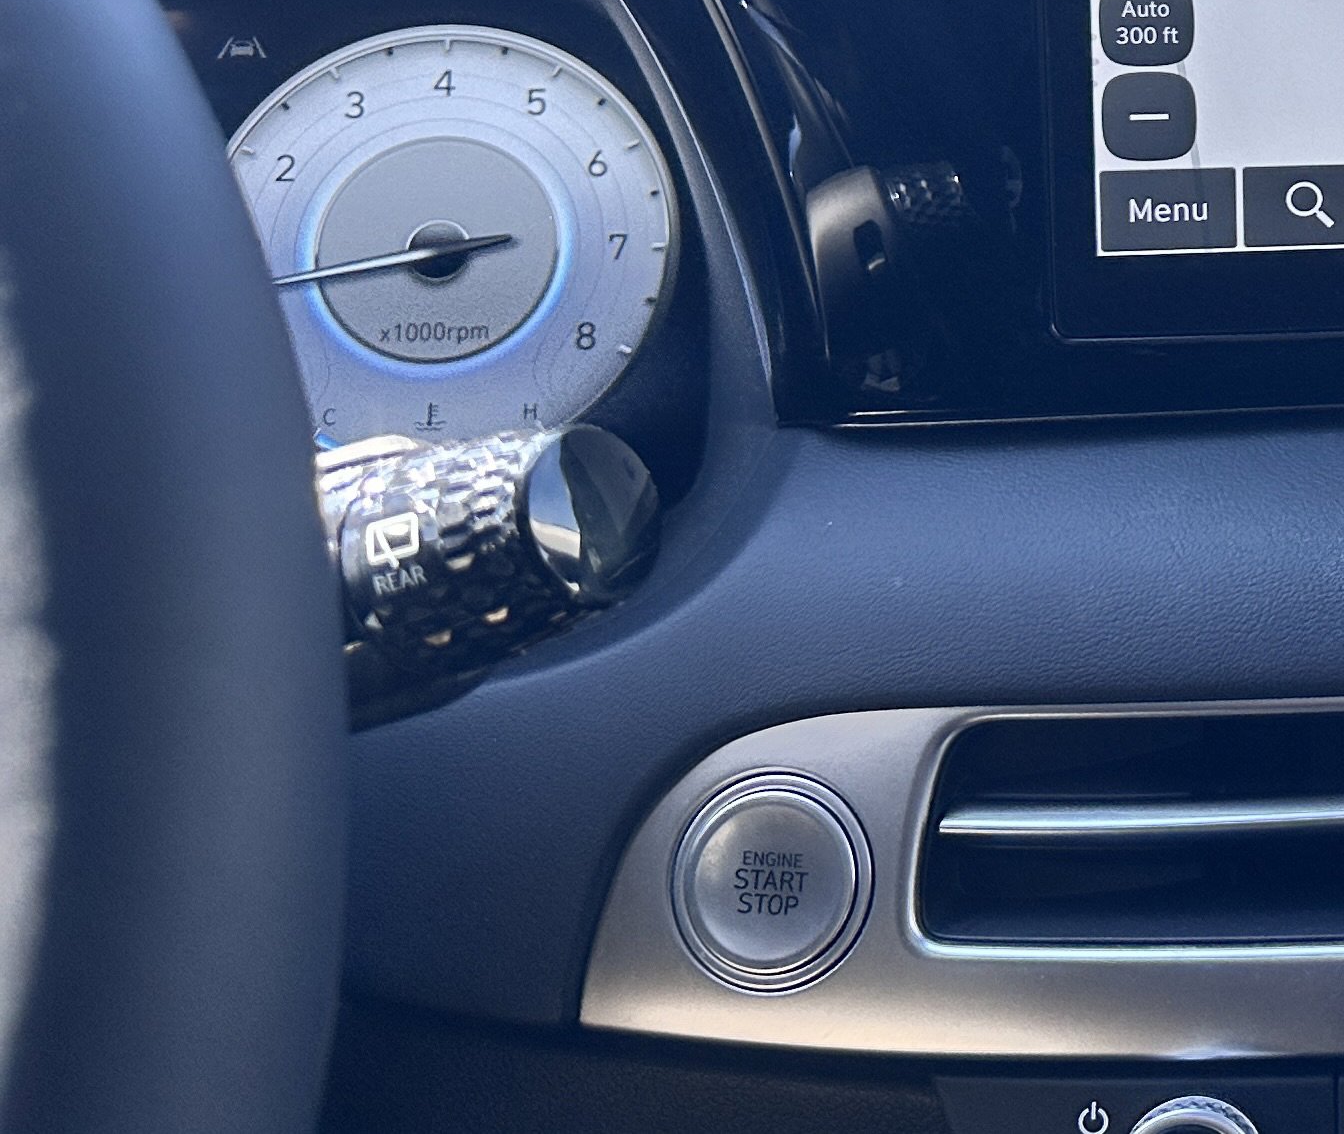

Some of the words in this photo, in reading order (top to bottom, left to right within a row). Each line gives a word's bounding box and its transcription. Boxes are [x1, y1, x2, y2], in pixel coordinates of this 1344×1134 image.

[1121, 0, 1170, 18] Auto
[1115, 26, 1158, 45] 300
[1162, 26, 1179, 44] ft
[433, 69, 456, 97] 4
[344, 90, 365, 119] 3
[527, 88, 547, 116] 5
[275, 154, 296, 182] 2
[587, 149, 609, 178] 6
[1128, 198, 1208, 223] Menu
[608, 233, 628, 261] 7
[378, 322, 490, 348] x1000rpm
[575, 321, 597, 351] 8
[322, 406, 337, 427] C
[372, 566, 427, 596] REAR
[742, 850, 804, 868] ENGINE
[733, 868, 809, 893] START
[737, 892, 799, 916] STOP
